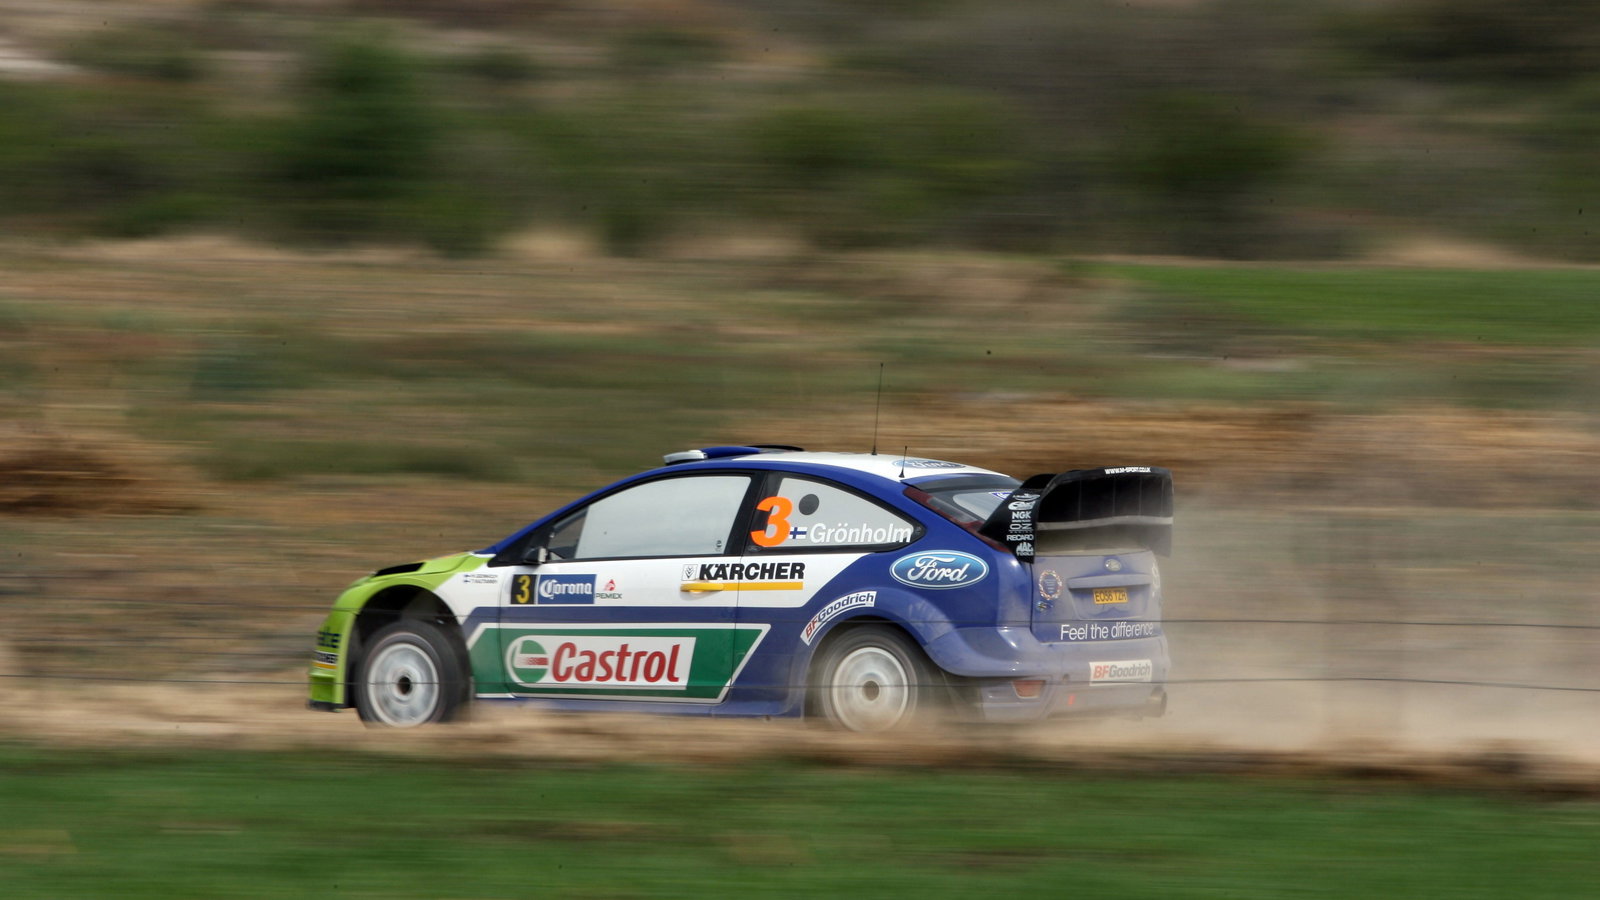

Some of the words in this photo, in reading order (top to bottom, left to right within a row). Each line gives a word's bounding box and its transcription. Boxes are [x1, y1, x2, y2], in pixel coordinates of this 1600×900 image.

[751, 496, 793, 547] 3
[1012, 511, 1031, 519] NGK
[810, 523, 913, 543] Grönholm
[699, 562, 806, 581] KÄRCHER
[907, 556, 970, 582] Ford
[516, 575, 531, 604] 3
[539, 579, 593, 600] Corona
[595, 592, 623, 600] PEMEX
[805, 592, 875, 638] BFGoodrich
[1060, 624, 1088, 640] Feel
[1090, 624, 1109, 639] the
[1111, 621, 1154, 638] difference
[552, 642, 681, 682] Castrol
[1093, 664, 1151, 679] BFGoodrich
